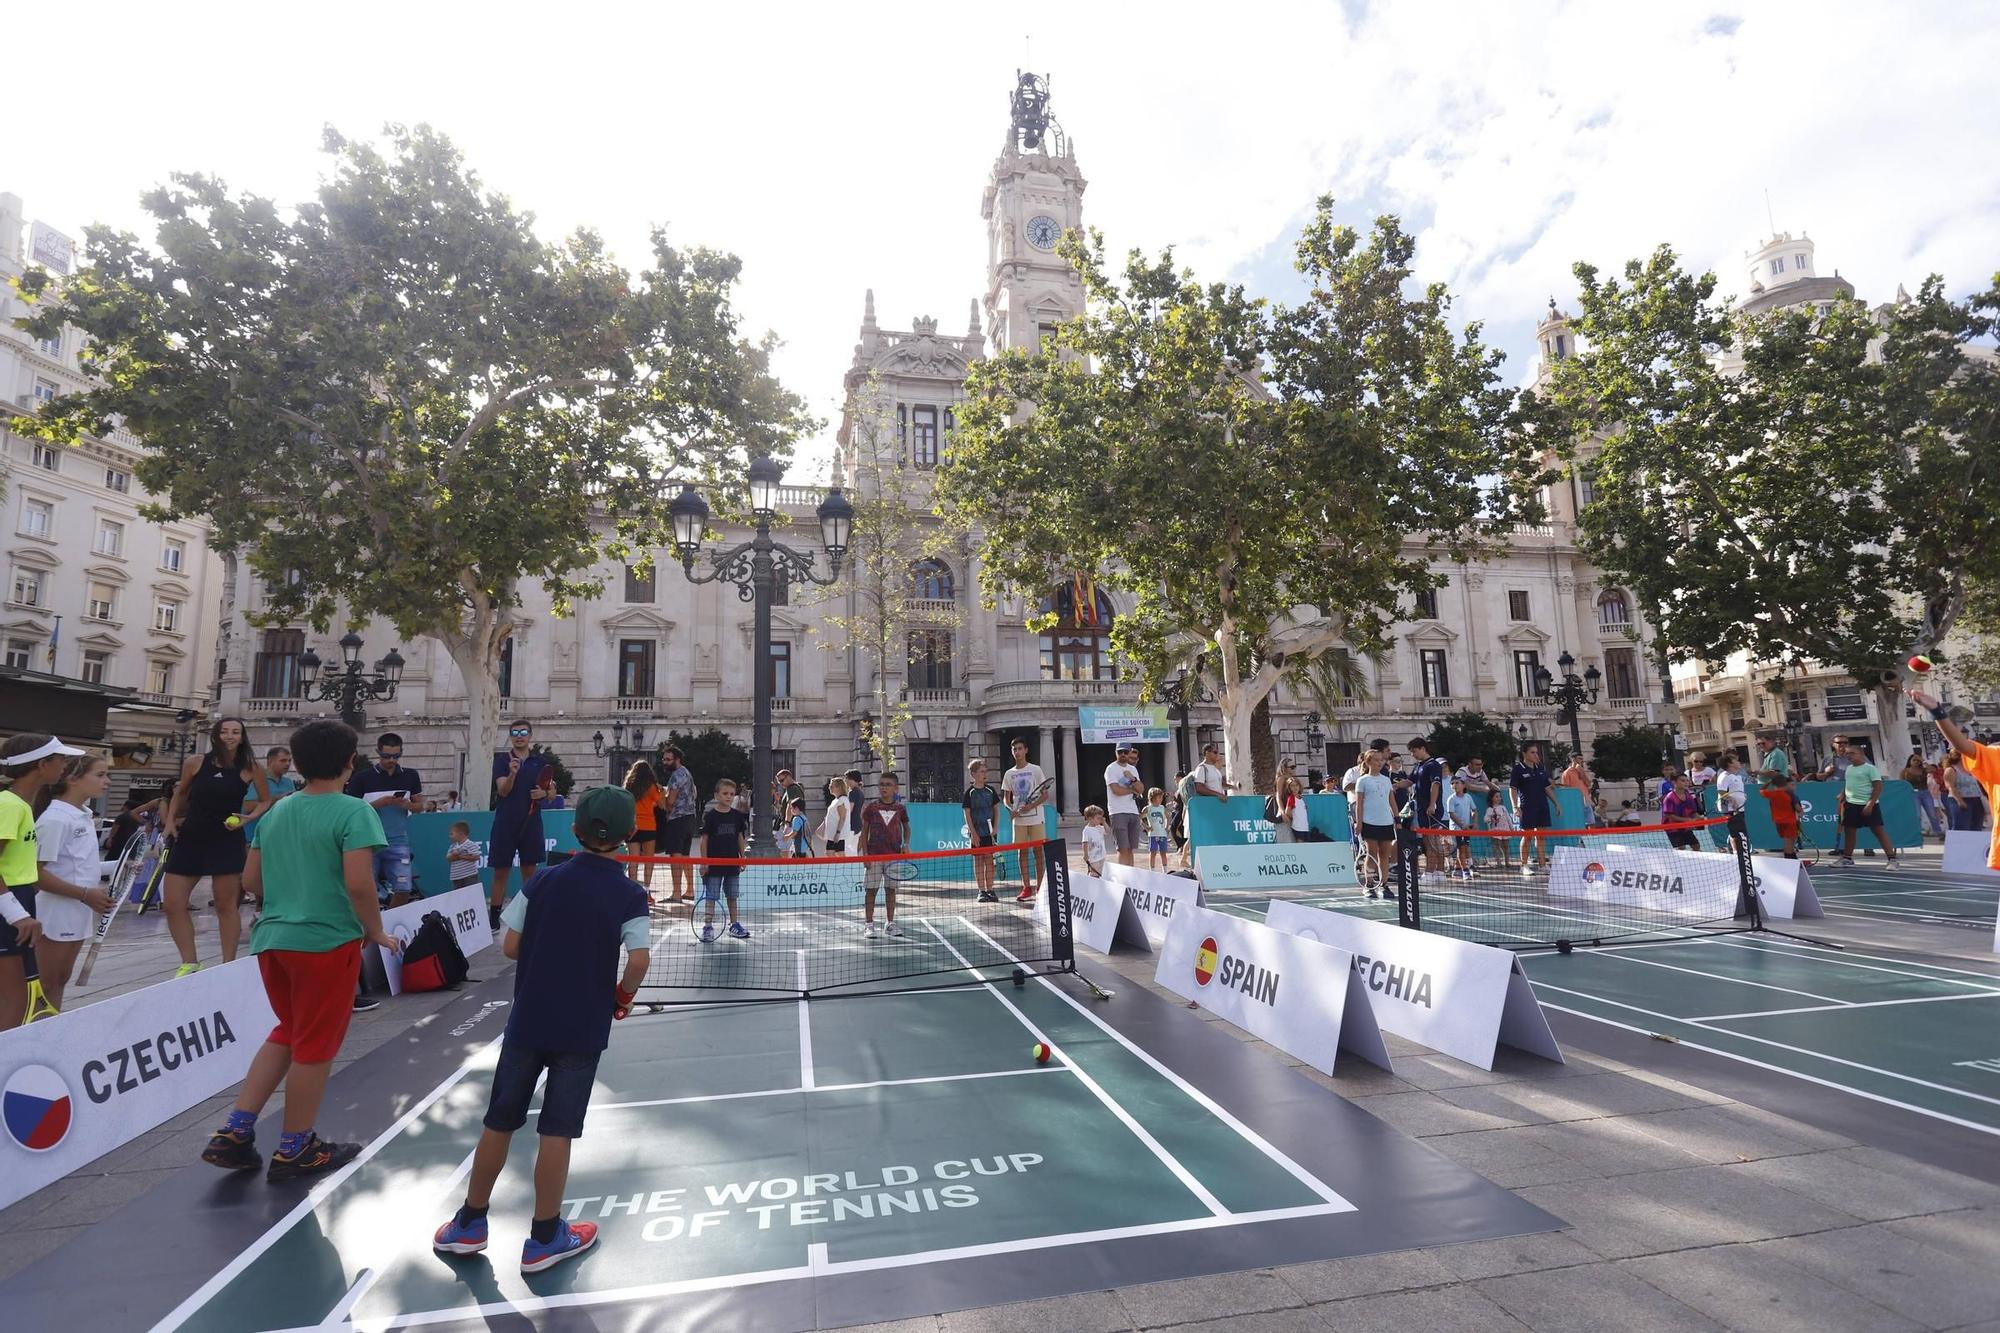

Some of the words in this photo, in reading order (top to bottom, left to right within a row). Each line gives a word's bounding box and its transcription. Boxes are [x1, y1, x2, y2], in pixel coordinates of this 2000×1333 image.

[1233, 820, 1251, 831] THE
[1254, 819, 1275, 831] WOR
[1247, 831, 1259, 843] OF
[1257, 864, 1308, 876] MALAGA
[1264, 855, 1285, 863] ROAD
[1287, 854, 1297, 862] TO
[1610, 869, 1684, 894] SERBIA
[1738, 831, 1754, 887] DUNLOP
[767, 882, 828, 896] MALAGA
[1055, 861, 1067, 924] DUNLOP
[1404, 861, 1414, 922] DUNLOP
[456, 908, 480, 934] REP.
[1220, 954, 1280, 1007] SPAIN
[1357, 955, 1431, 1009] ECHIA
[82, 1010, 236, 1103] CZECHIA
[562, 1189, 687, 1220] THE
[702, 1165, 918, 1204] WORLD
[932, 1152, 1044, 1179] CUP
[640, 1211, 733, 1242] OF
[746, 1185, 979, 1230] TENNIS
